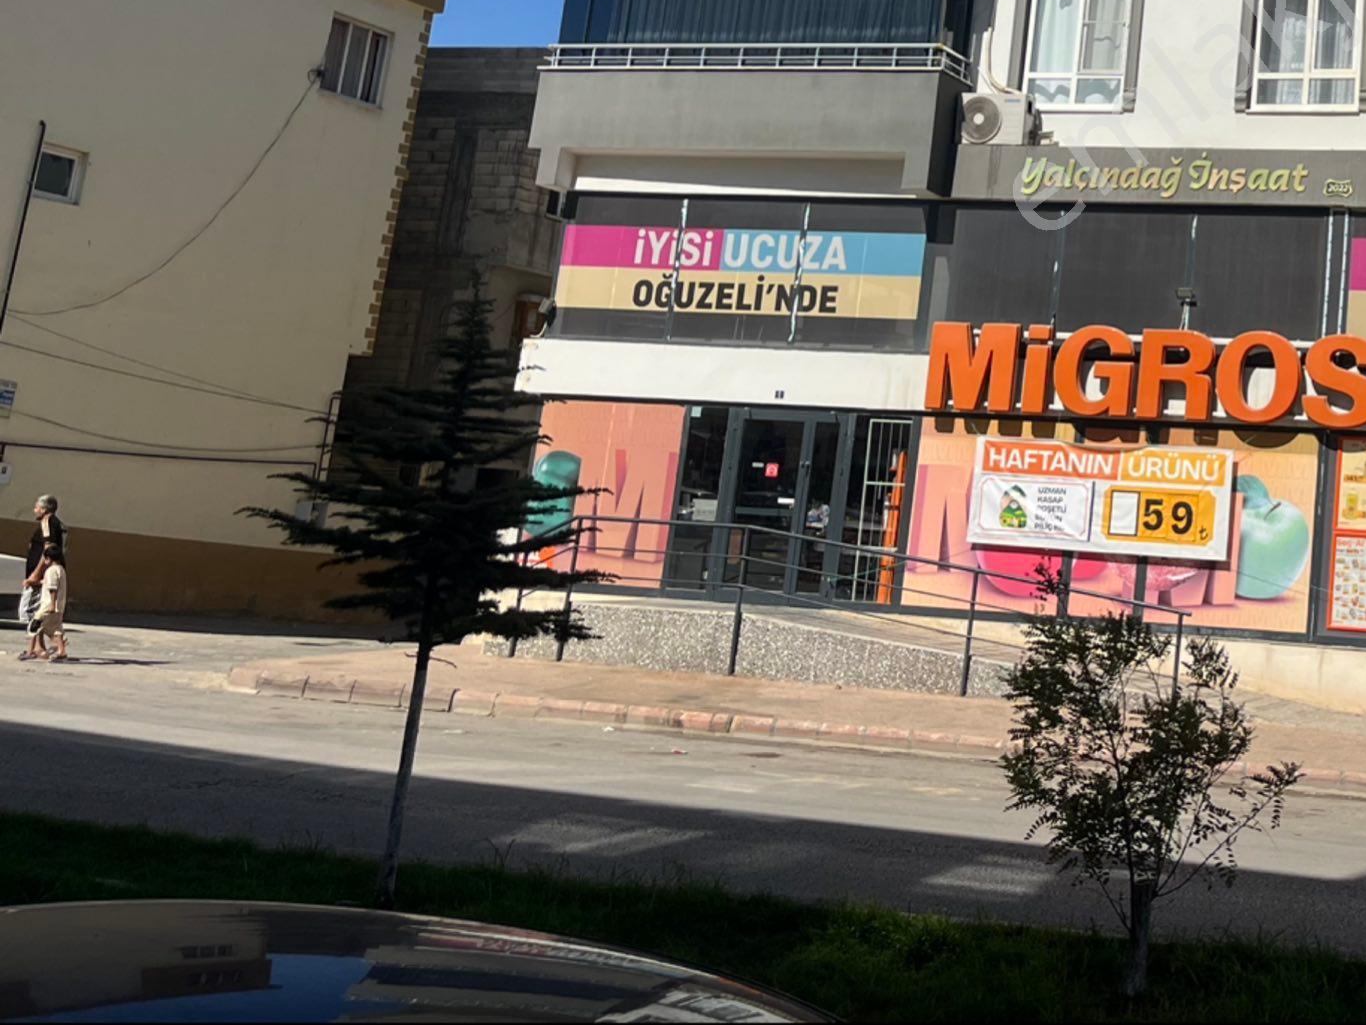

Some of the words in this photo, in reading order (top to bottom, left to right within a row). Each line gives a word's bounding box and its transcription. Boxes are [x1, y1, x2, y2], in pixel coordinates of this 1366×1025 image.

[1020, 156, 1184, 199] Yalçındağ
[1187, 151, 1310, 195] İnşaat
[723, 232, 847, 271] UCUZA
[988, 446, 1114, 475] HAFTANIN
[1127, 450, 1220, 482] ÜRÜNÜ
